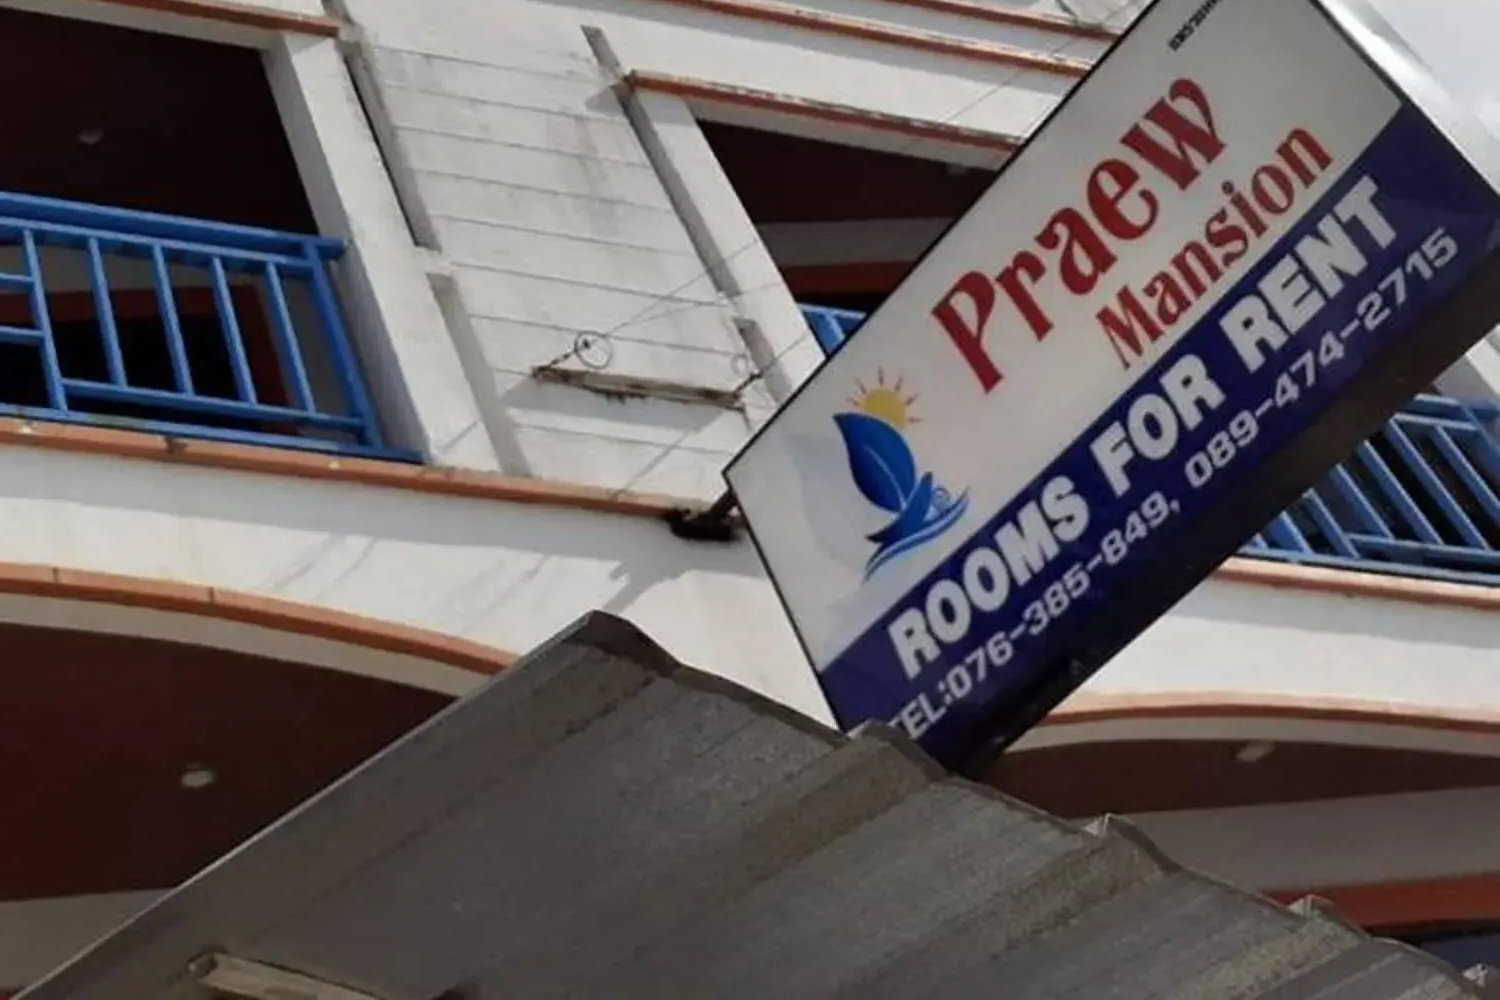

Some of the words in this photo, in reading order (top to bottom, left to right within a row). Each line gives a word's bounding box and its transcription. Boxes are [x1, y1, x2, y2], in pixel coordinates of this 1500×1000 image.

[887, 475, 1090, 680] ROOMS
[1089, 354, 1226, 498] FOR
[1218, 174, 1397, 374] RENT
[931, 77, 1228, 394] Praew
[1095, 127, 1333, 370] Mansion
[886, 491, 1180, 740] EL:076-385-849,
[1184, 226, 1459, 488] 089-474-2715
